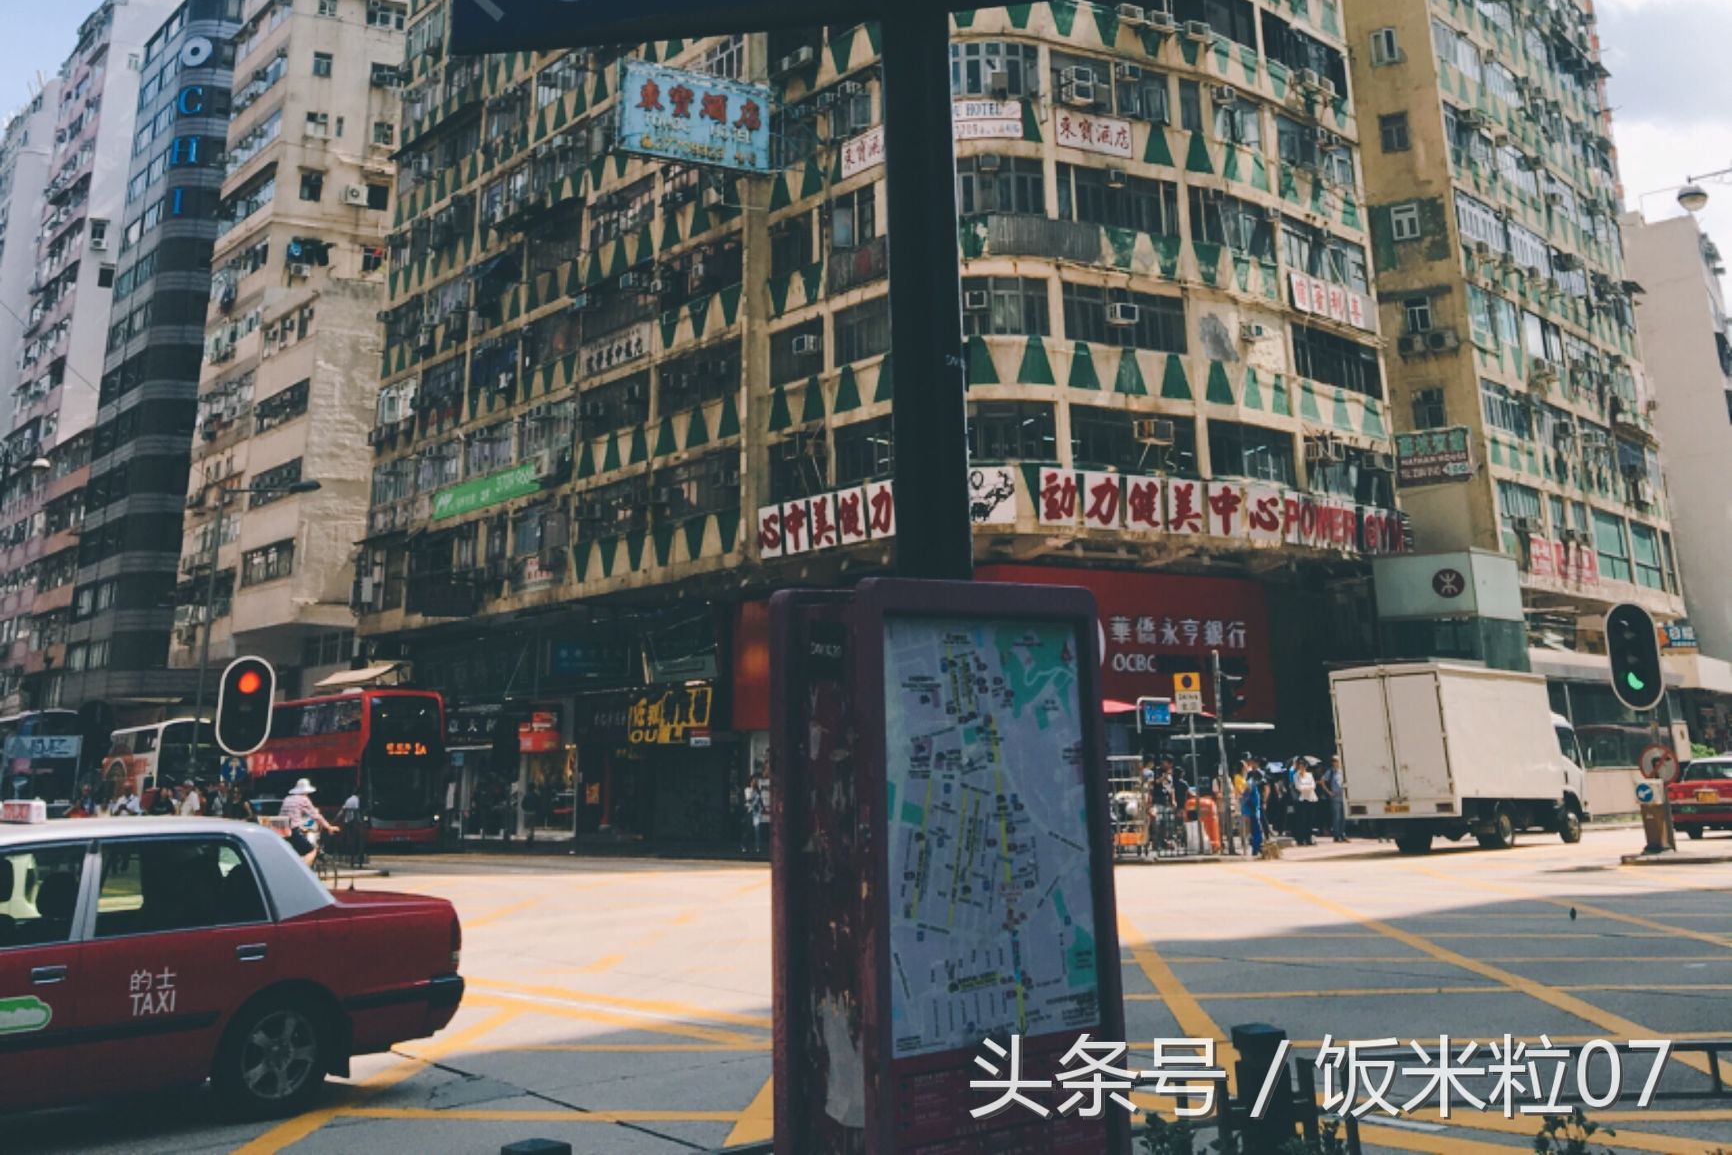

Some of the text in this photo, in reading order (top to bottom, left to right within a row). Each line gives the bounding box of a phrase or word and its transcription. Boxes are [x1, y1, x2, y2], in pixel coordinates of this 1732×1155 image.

[634, 78, 762, 131] 東寶酒店
[966, 102, 1003, 116] HOTEL
[1059, 115, 1130, 150] 東寶酒店
[1039, 472, 1281, 536] 動力健美中心
[1283, 497, 1356, 546] POWER
[1109, 616, 1247, 649] 華僑永亨銀行
[1112, 653, 1157, 673] OCBC
[129, 967, 177, 992] 的士
[129, 989, 177, 1017] TAXI
